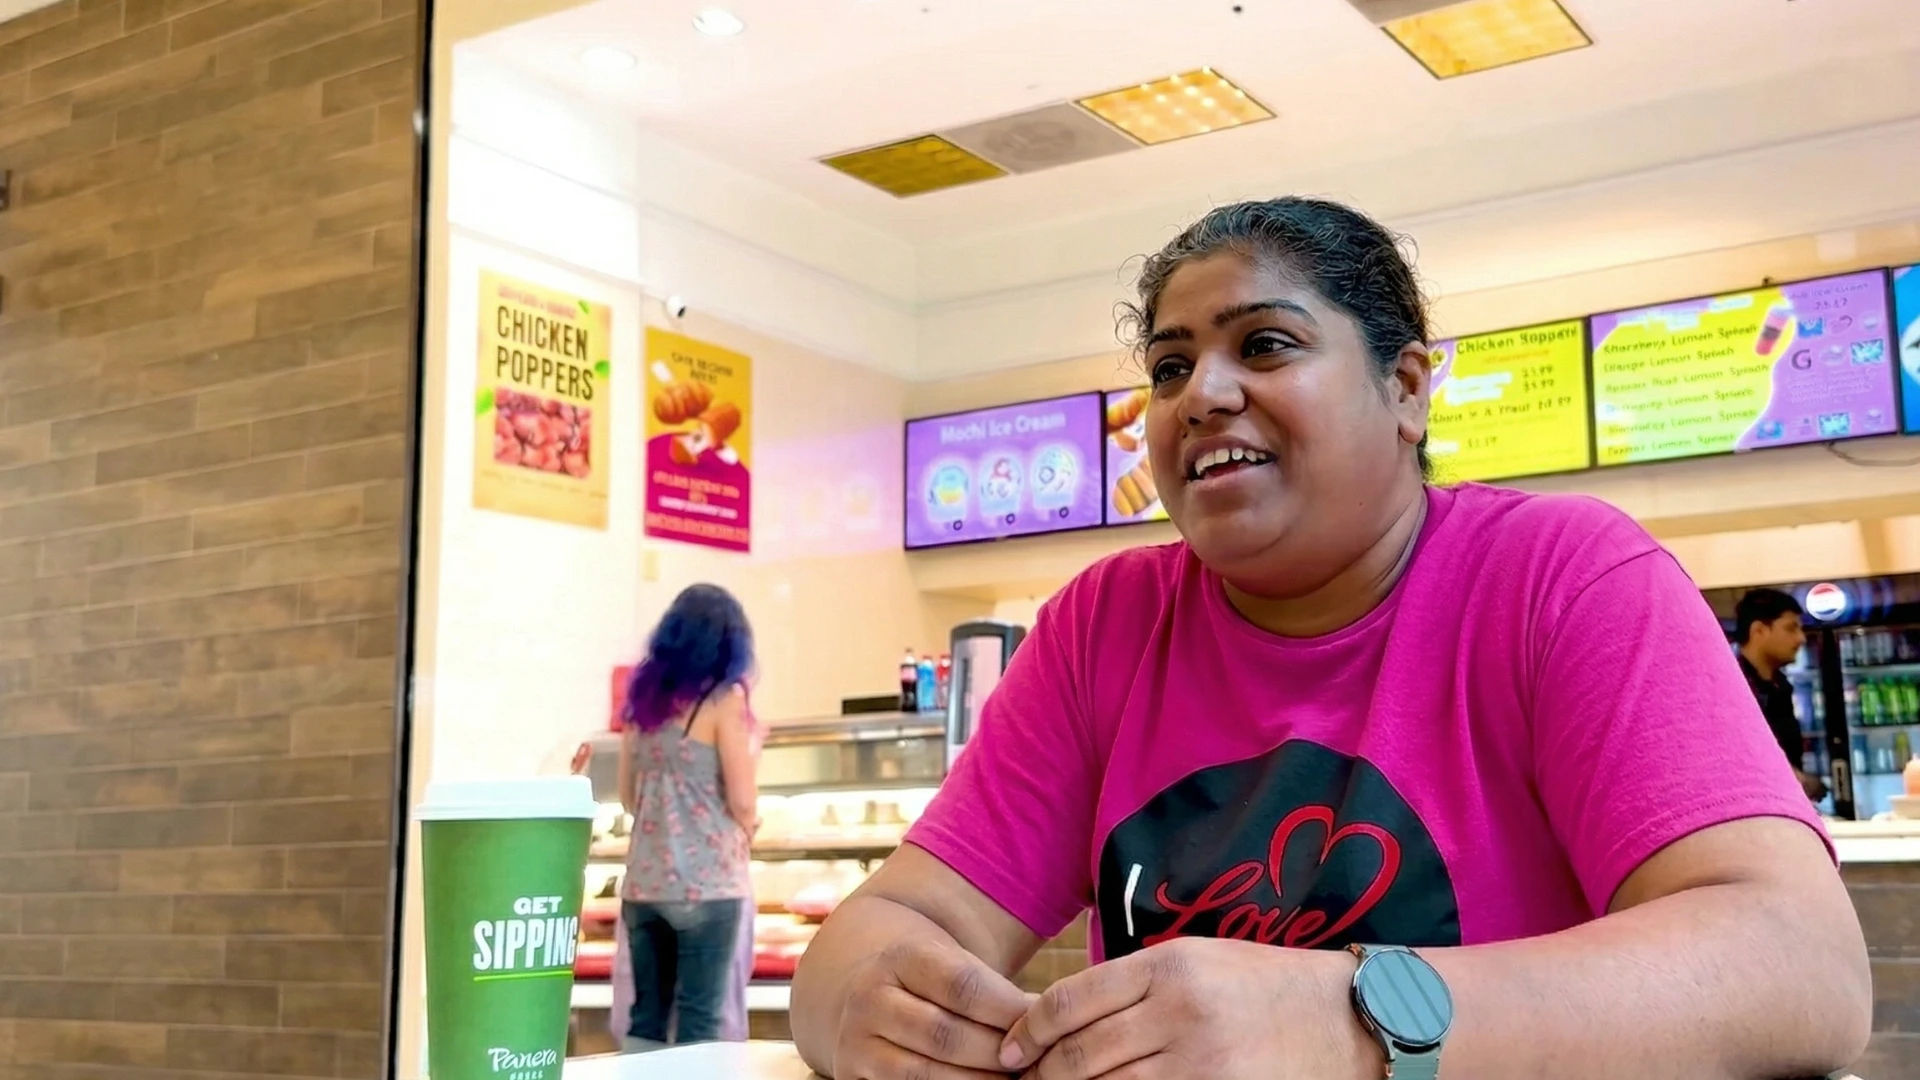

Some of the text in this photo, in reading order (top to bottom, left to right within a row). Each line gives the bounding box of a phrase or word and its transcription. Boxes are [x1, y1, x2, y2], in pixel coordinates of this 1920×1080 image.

[497, 305, 588, 361] CHICKEN
[1456, 338, 1514, 355] Chicken
[496, 346, 594, 402] POPPERS
[941, 412, 1066, 444] Mochi Ice Cream
[513, 896, 563, 915] GET
[1123, 860, 1331, 948] I Love
[473, 916, 578, 970] SIPPING
[487, 1047, 557, 1072] Panera
